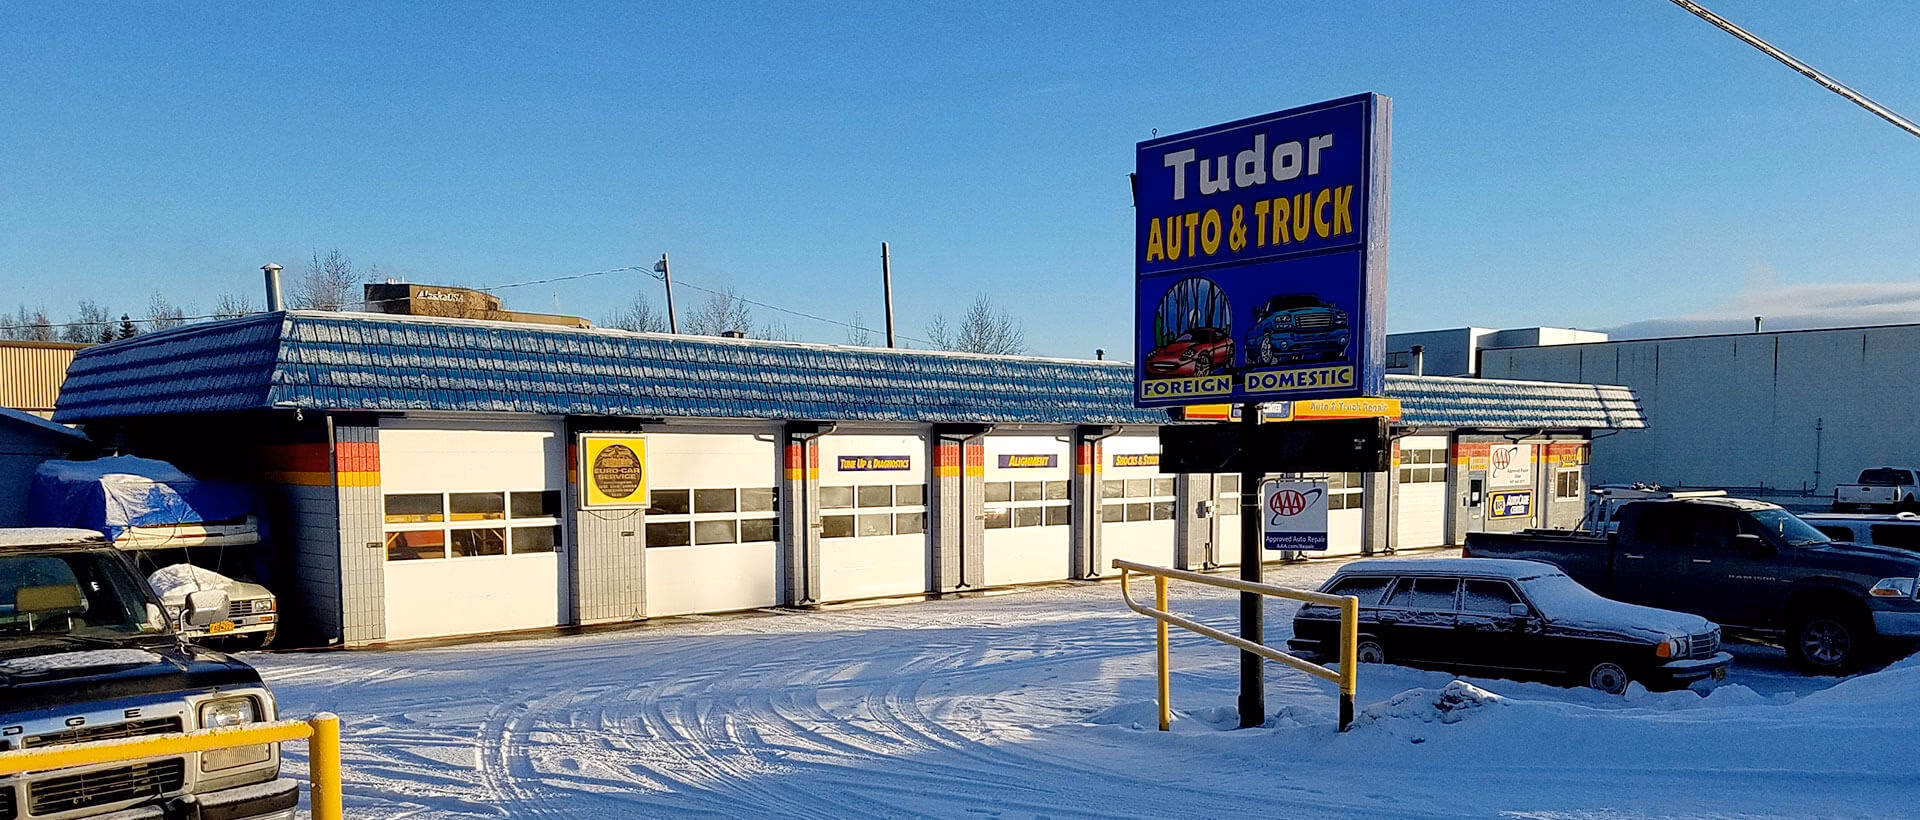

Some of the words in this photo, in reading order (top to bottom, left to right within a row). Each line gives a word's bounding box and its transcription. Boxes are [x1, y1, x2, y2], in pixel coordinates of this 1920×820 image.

[1163, 133, 1333, 201] Tudor
[1146, 208, 1222, 263] AUTO
[1229, 204, 1247, 252] &
[1255, 185, 1353, 248] TRUCK
[1143, 377, 1230, 396] FOREIGN
[1248, 368, 1350, 390] DOMESTIC
[1310, 401, 1329, 411] Auto
[1339, 401, 1361, 411] Truck
[1363, 401, 1389, 413] Repair
[840, 458, 857, 469] TUNE
[857, 458, 867, 469] UP
[873, 458, 909, 469] DIAGNOSTICS
[1008, 455, 1050, 467] ALIGNMENT
[1115, 455, 1138, 466] SHOCKS
[1272, 490, 1305, 516] AAA
[1265, 536, 1292, 544] Approved
[1307, 536, 1326, 544] Repair
